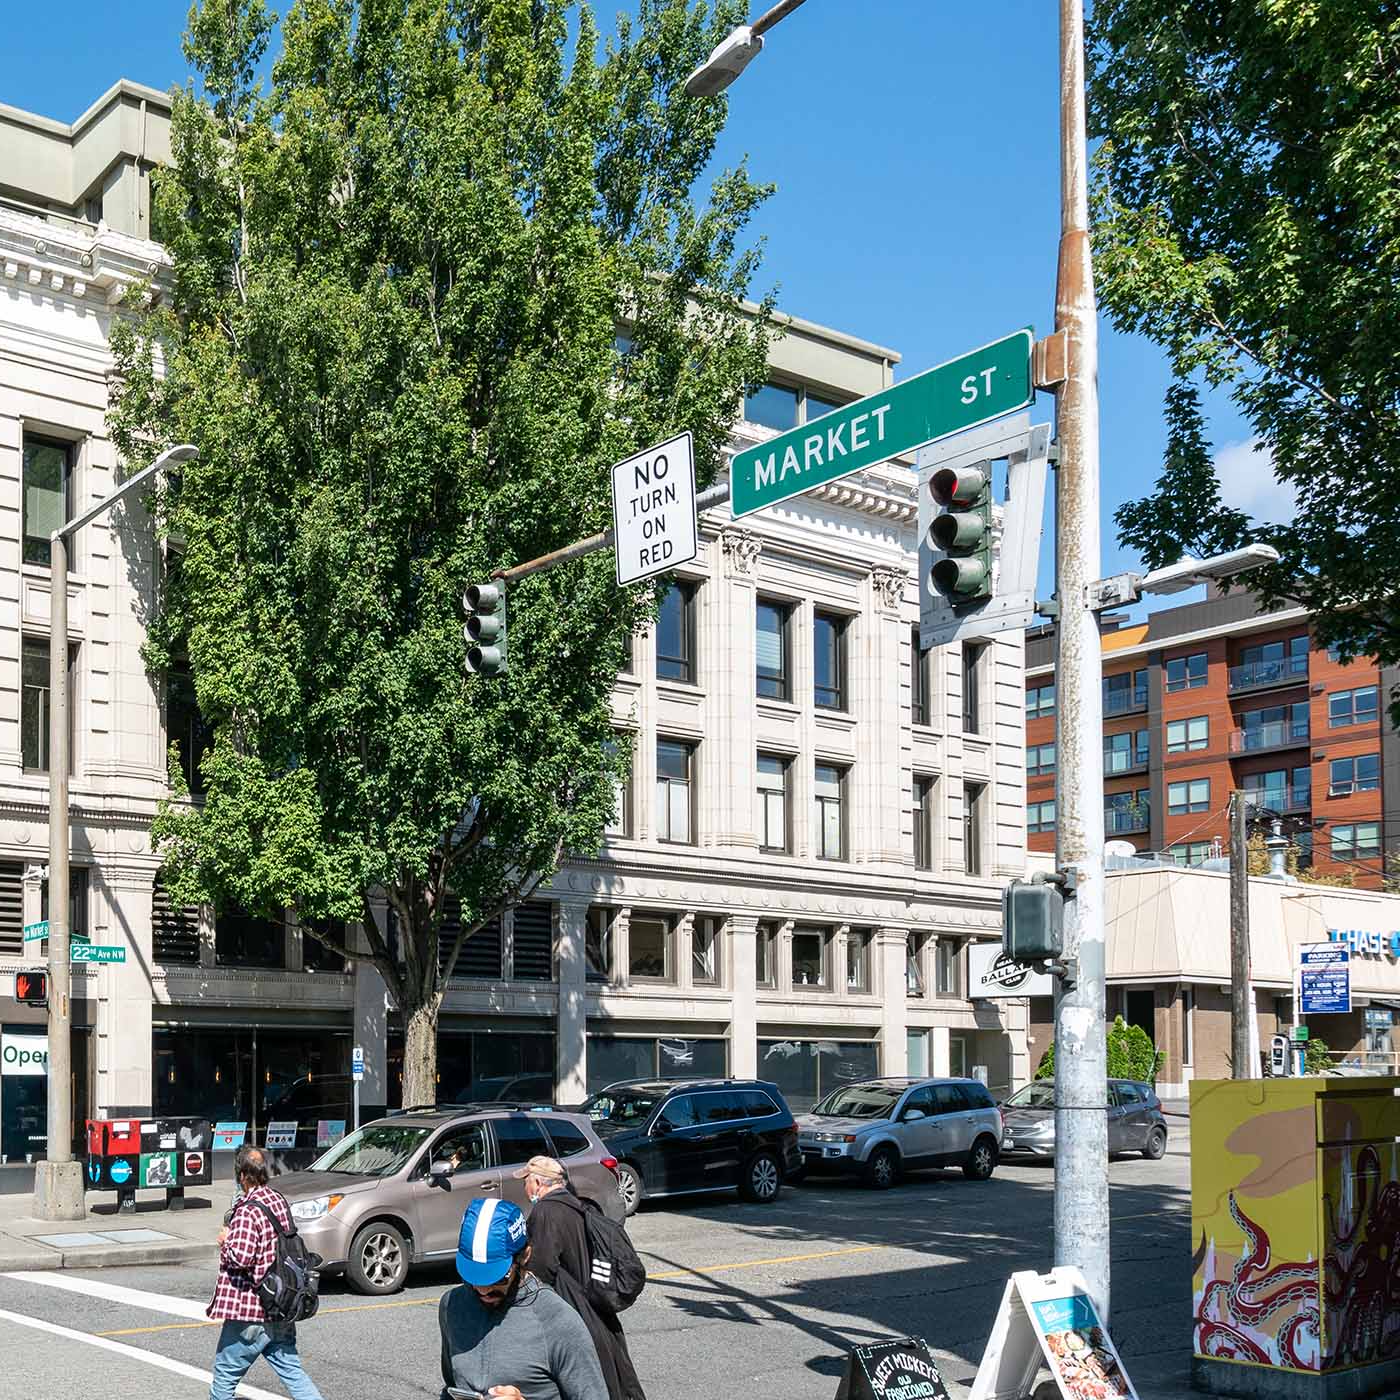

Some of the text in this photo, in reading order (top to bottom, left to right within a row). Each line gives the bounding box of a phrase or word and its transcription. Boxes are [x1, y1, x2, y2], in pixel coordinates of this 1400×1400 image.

[754, 366, 997, 491] MARKET ST
[634, 454, 669, 490] NO
[630, 483, 676, 518] TURN
[642, 516, 666, 539] ON
[639, 540, 673, 569] RED
[97, 949, 111, 960] Ave
[112, 950, 124, 960] NW
[871, 1353, 939, 1396] SWEET MICKEYS
[897, 1374, 912, 1386] OLD
[884, 1381, 934, 1400] FASHIONED
